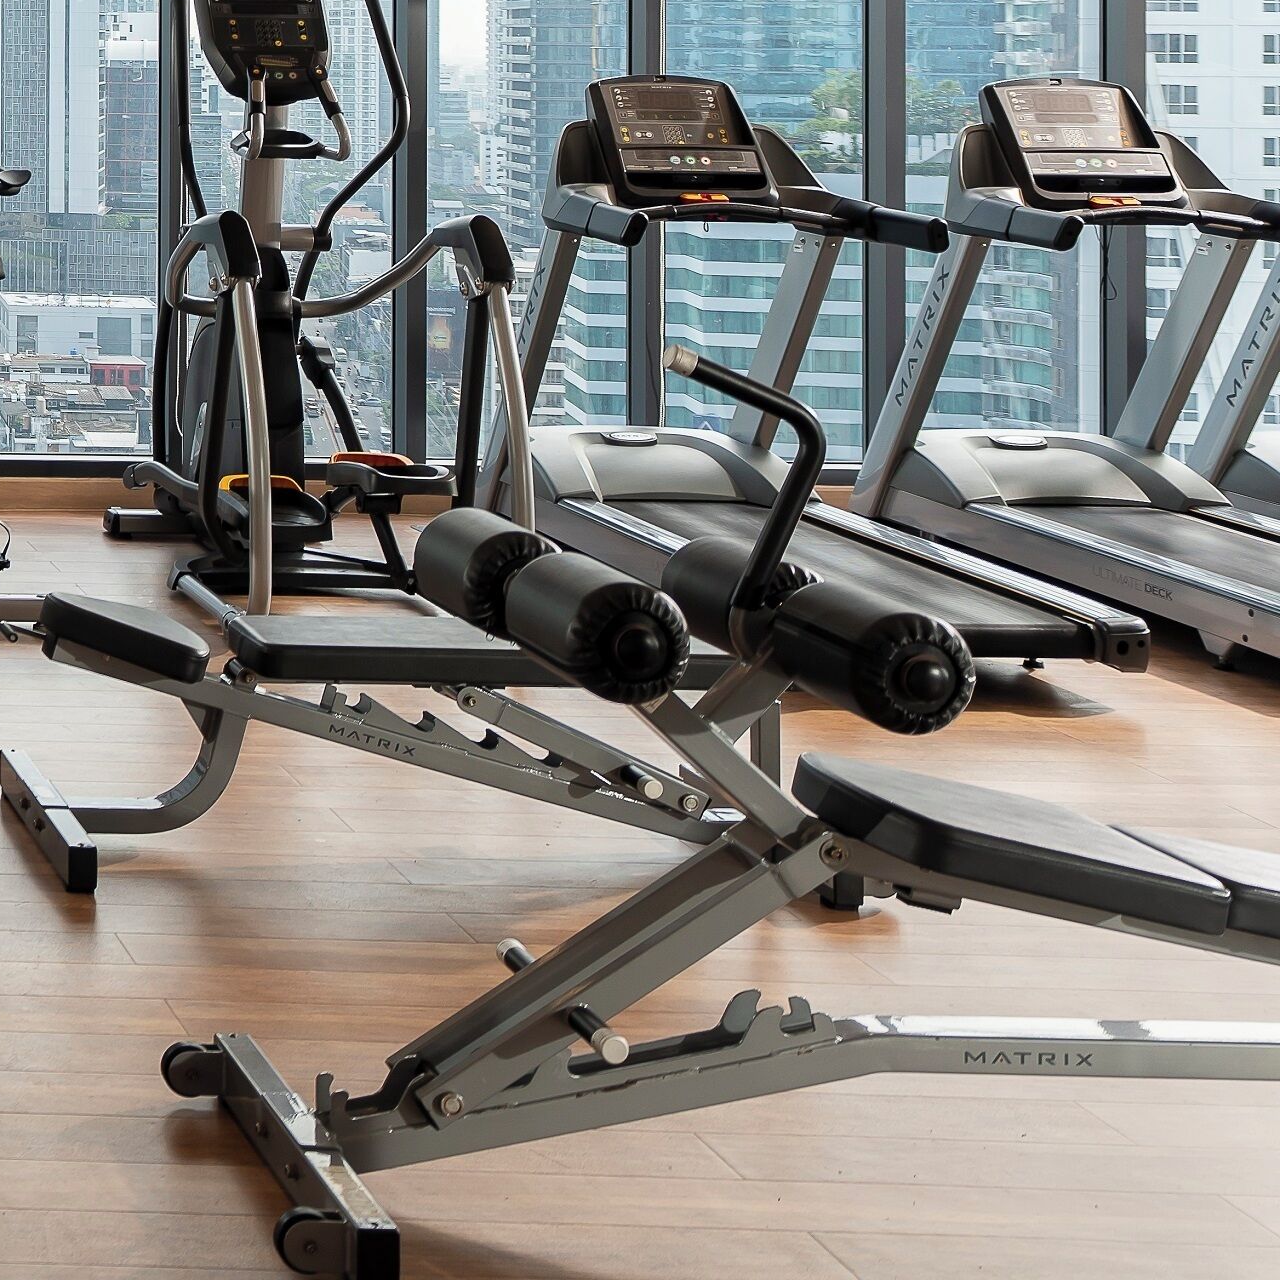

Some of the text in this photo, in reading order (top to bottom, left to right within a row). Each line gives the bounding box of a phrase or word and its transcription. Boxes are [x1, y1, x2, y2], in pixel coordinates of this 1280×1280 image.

[517, 266, 546, 358] TRIX
[894, 263, 950, 407] MATRIX
[1226, 277, 1280, 407] MATRI
[1092, 564, 1173, 601] ULTIMATE DECK
[328, 724, 416, 757] MATRIX
[964, 1051, 1093, 1067] MATRIX
